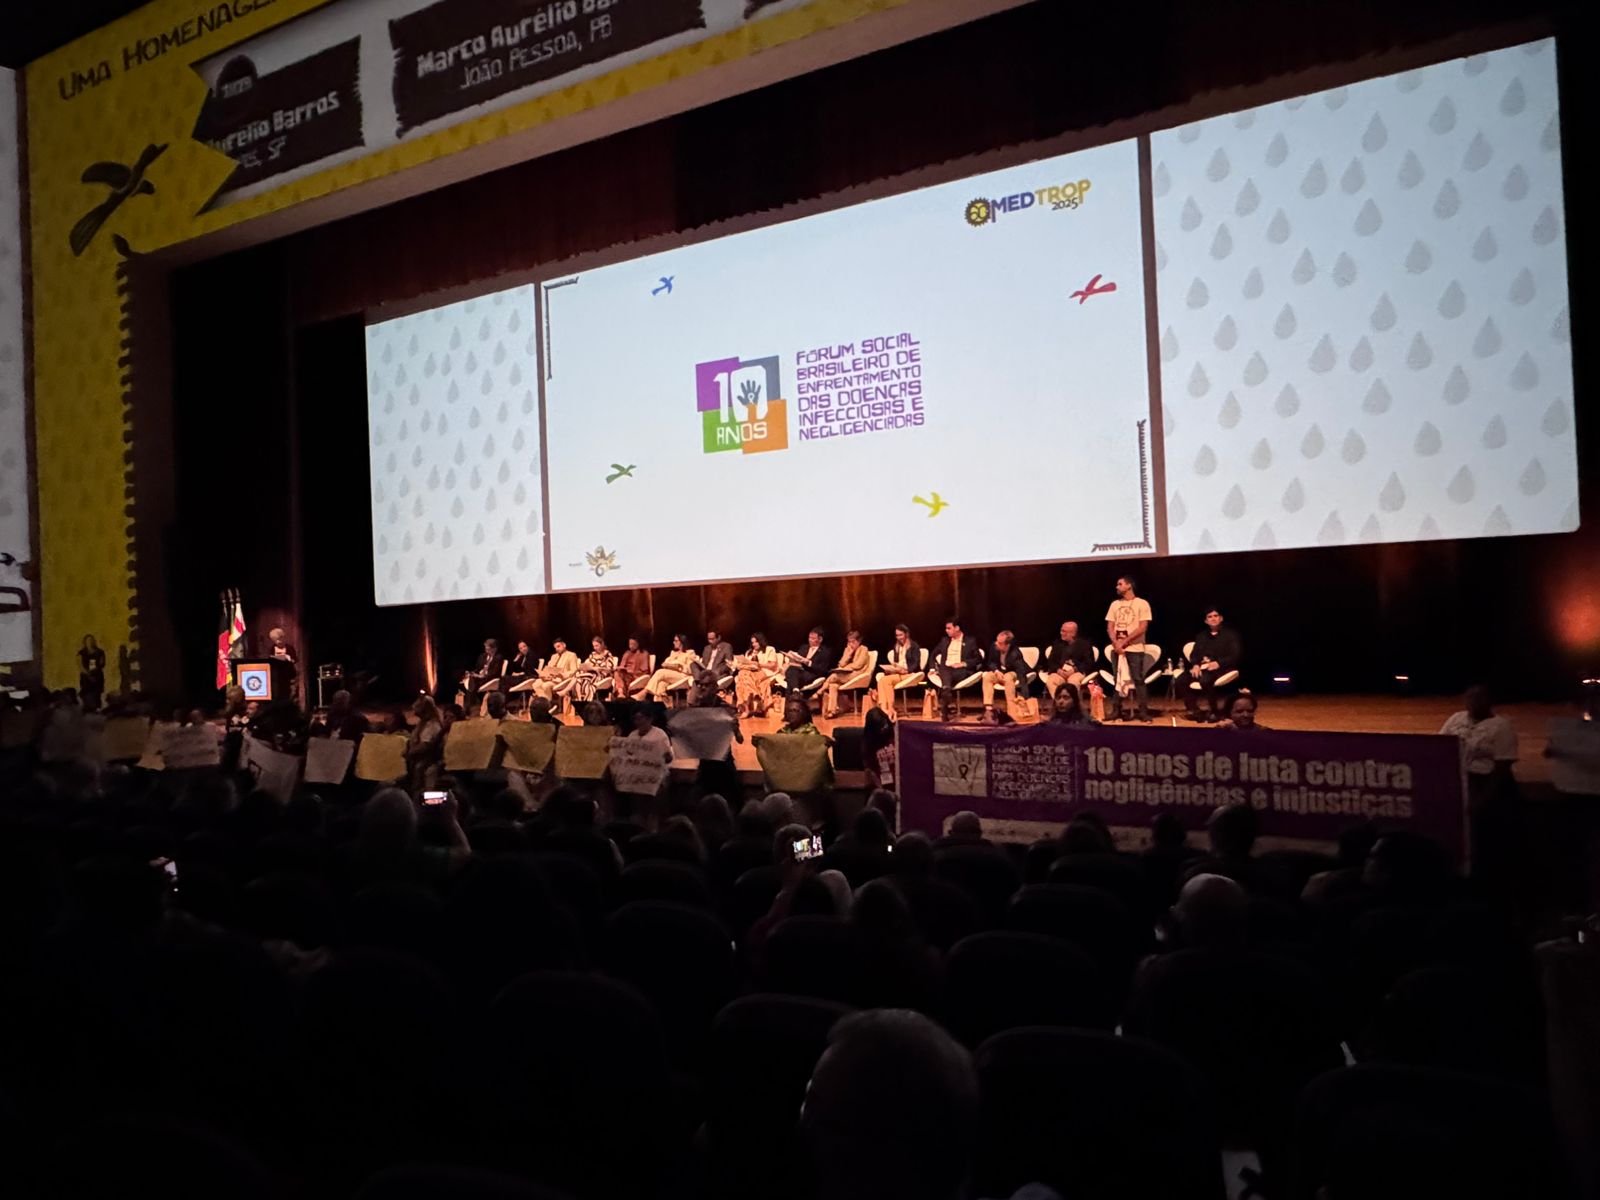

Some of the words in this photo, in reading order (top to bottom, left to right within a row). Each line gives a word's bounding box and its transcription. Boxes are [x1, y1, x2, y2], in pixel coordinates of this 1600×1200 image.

[416, 34, 486, 78] Marco
[490, 0, 577, 48] Aurélio
[590, 13, 612, 43] PB
[58, 62, 112, 101] UMA
[272, 90, 340, 132] Barros
[1051, 197, 1079, 211] 2025
[861, 332, 920, 354] SOCIAL
[796, 353, 889, 381] BRASILEIRO
[896, 348, 921, 366] DE
[797, 364, 921, 394] ENFRENTAMENTO
[713, 365, 768, 424] 10
[798, 393, 831, 412] DAS
[799, 399, 905, 427] INFECCIOSAS
[911, 396, 924, 412] E
[799, 412, 925, 441] NEGLIGENCIADAS
[717, 421, 768, 445] ANOS
[1083, 746, 1115, 775] 10
[1120, 751, 1190, 779] anos
[1195, 750, 1233, 781] de
[1239, 752, 1299, 784] luta
[1305, 759, 1412, 790] contra
[1084, 777, 1247, 807] negligências
[1250, 787, 1268, 811] e
